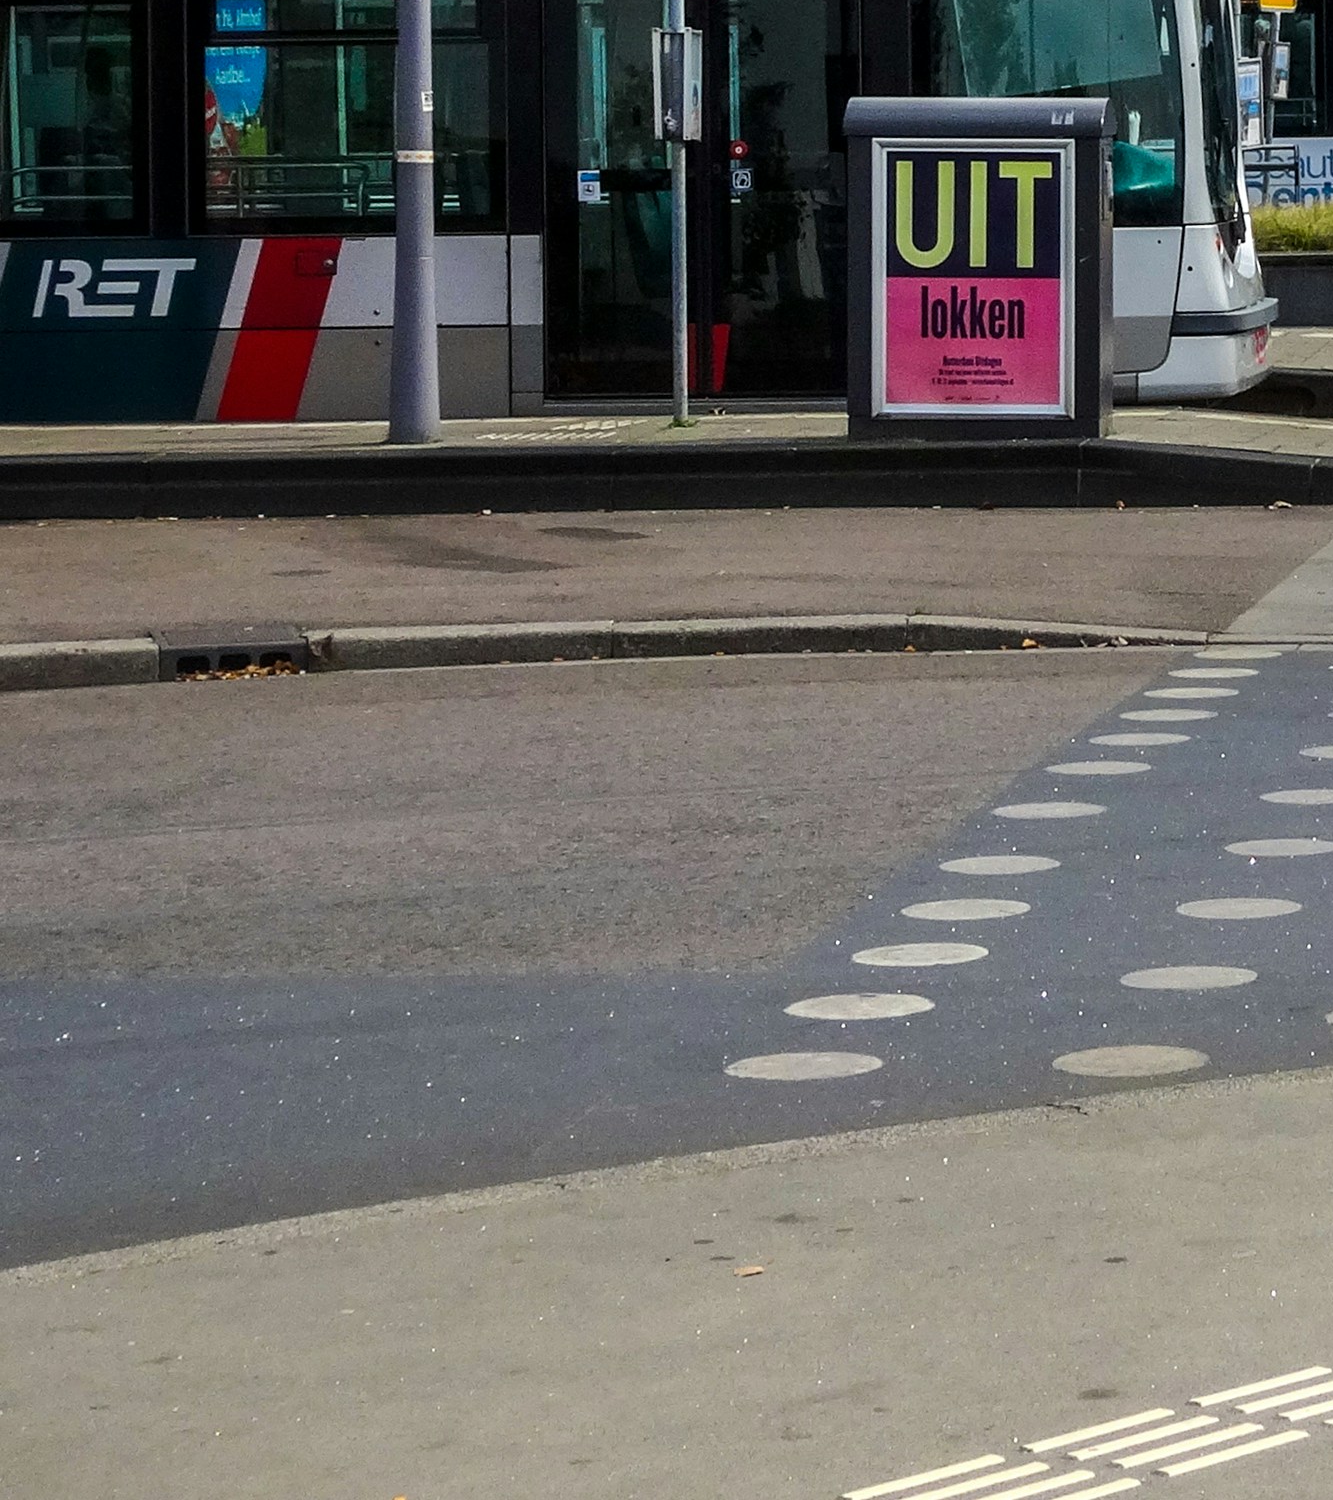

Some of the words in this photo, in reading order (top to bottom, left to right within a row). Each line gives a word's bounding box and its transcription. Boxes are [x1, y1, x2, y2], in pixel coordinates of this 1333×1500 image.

[895, 160, 1053, 269] UIT
[32, 257, 197, 318] RET
[920, 285, 1025, 339] lokken
